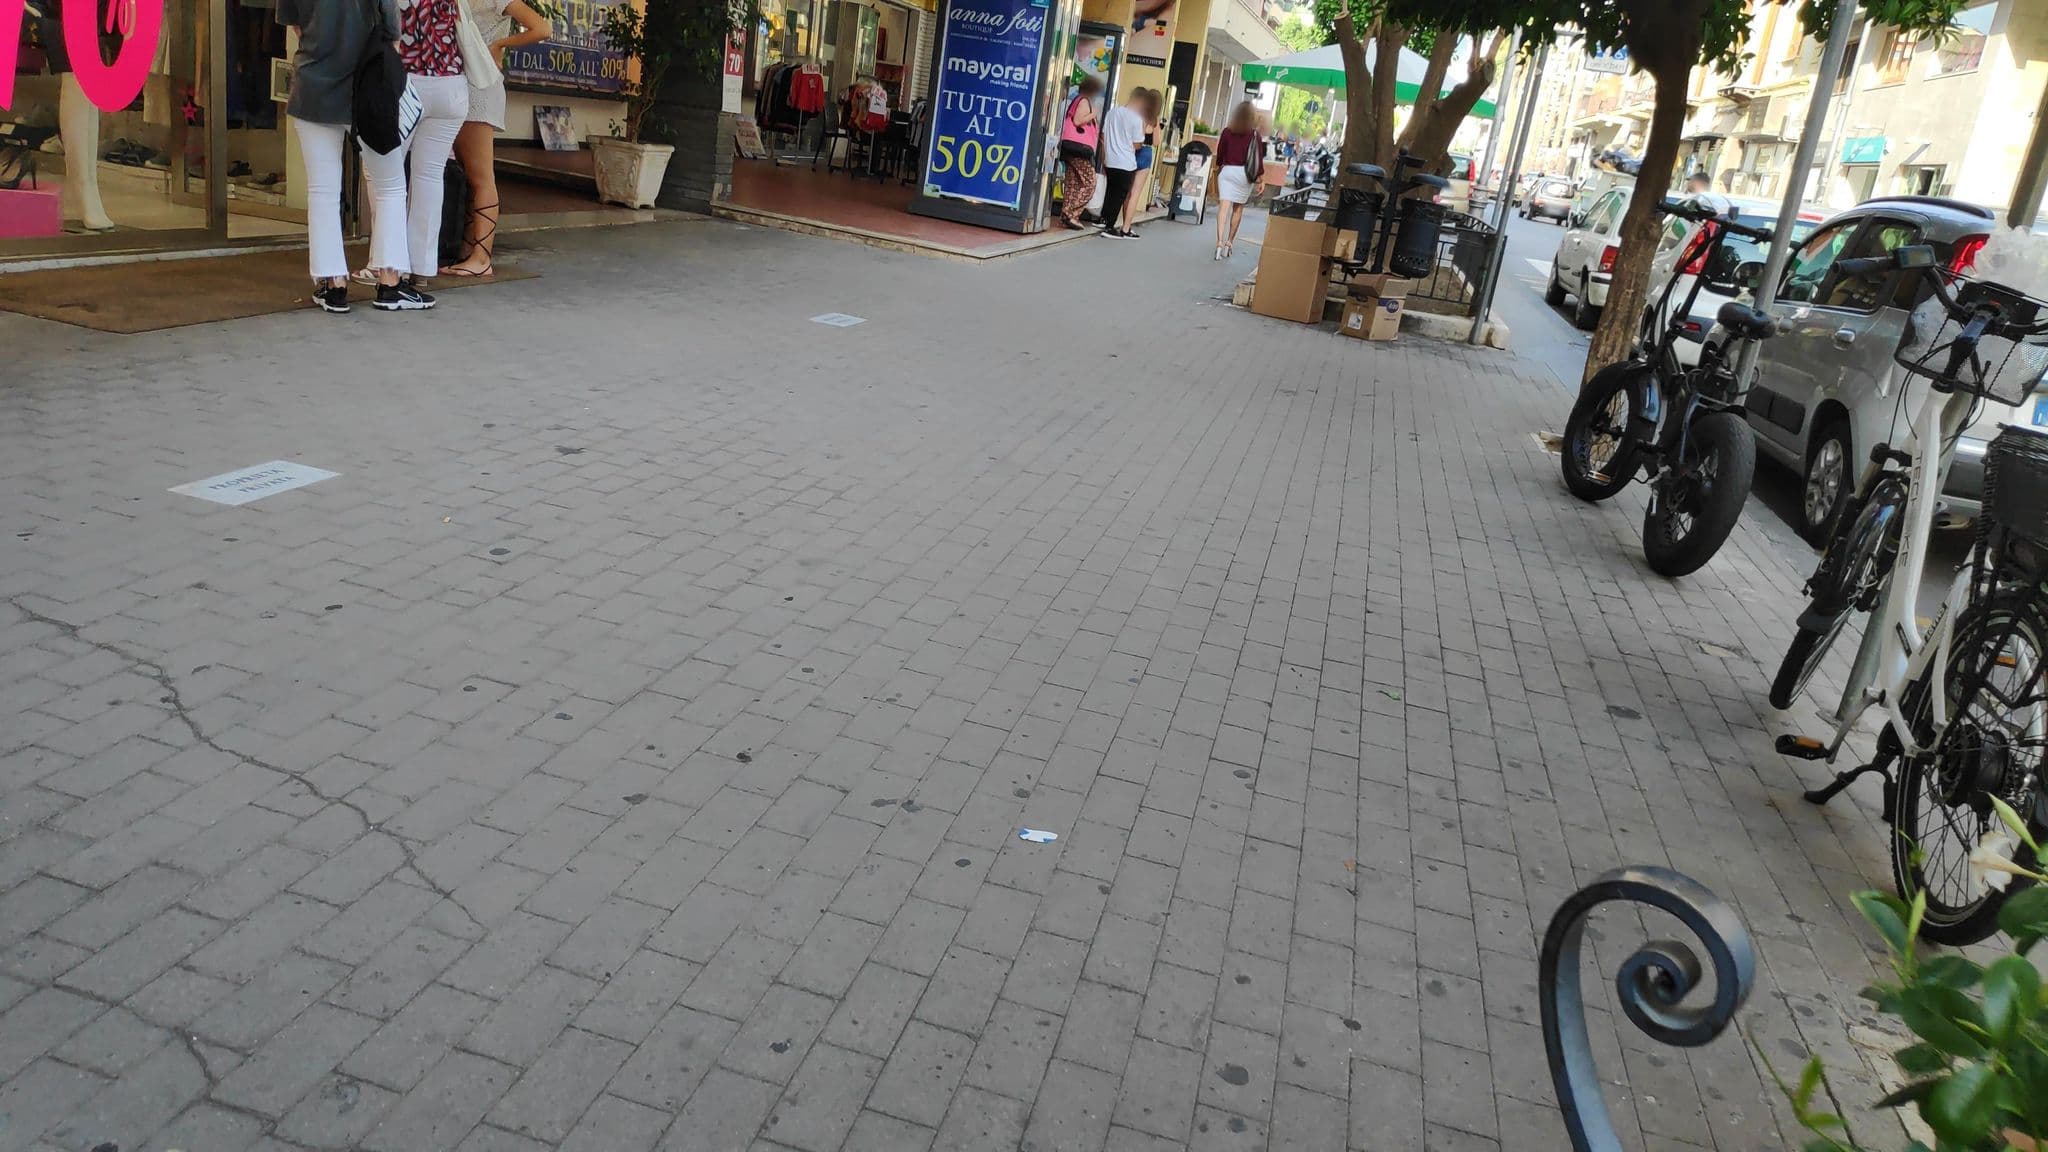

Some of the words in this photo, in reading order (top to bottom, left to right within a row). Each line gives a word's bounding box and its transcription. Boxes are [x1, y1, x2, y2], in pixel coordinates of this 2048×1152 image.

[951, 7, 1005, 26] anna
[996, 8, 1043, 36] foti
[522, 51, 545, 71] DAL
[547, 49, 577, 74] 50%
[600, 57, 626, 80] 80%
[947, 56, 1032, 83] mayoral
[942, 89, 1027, 121] TUTTO
[964, 114, 996, 137] AL
[931, 135, 1020, 185] 50%
